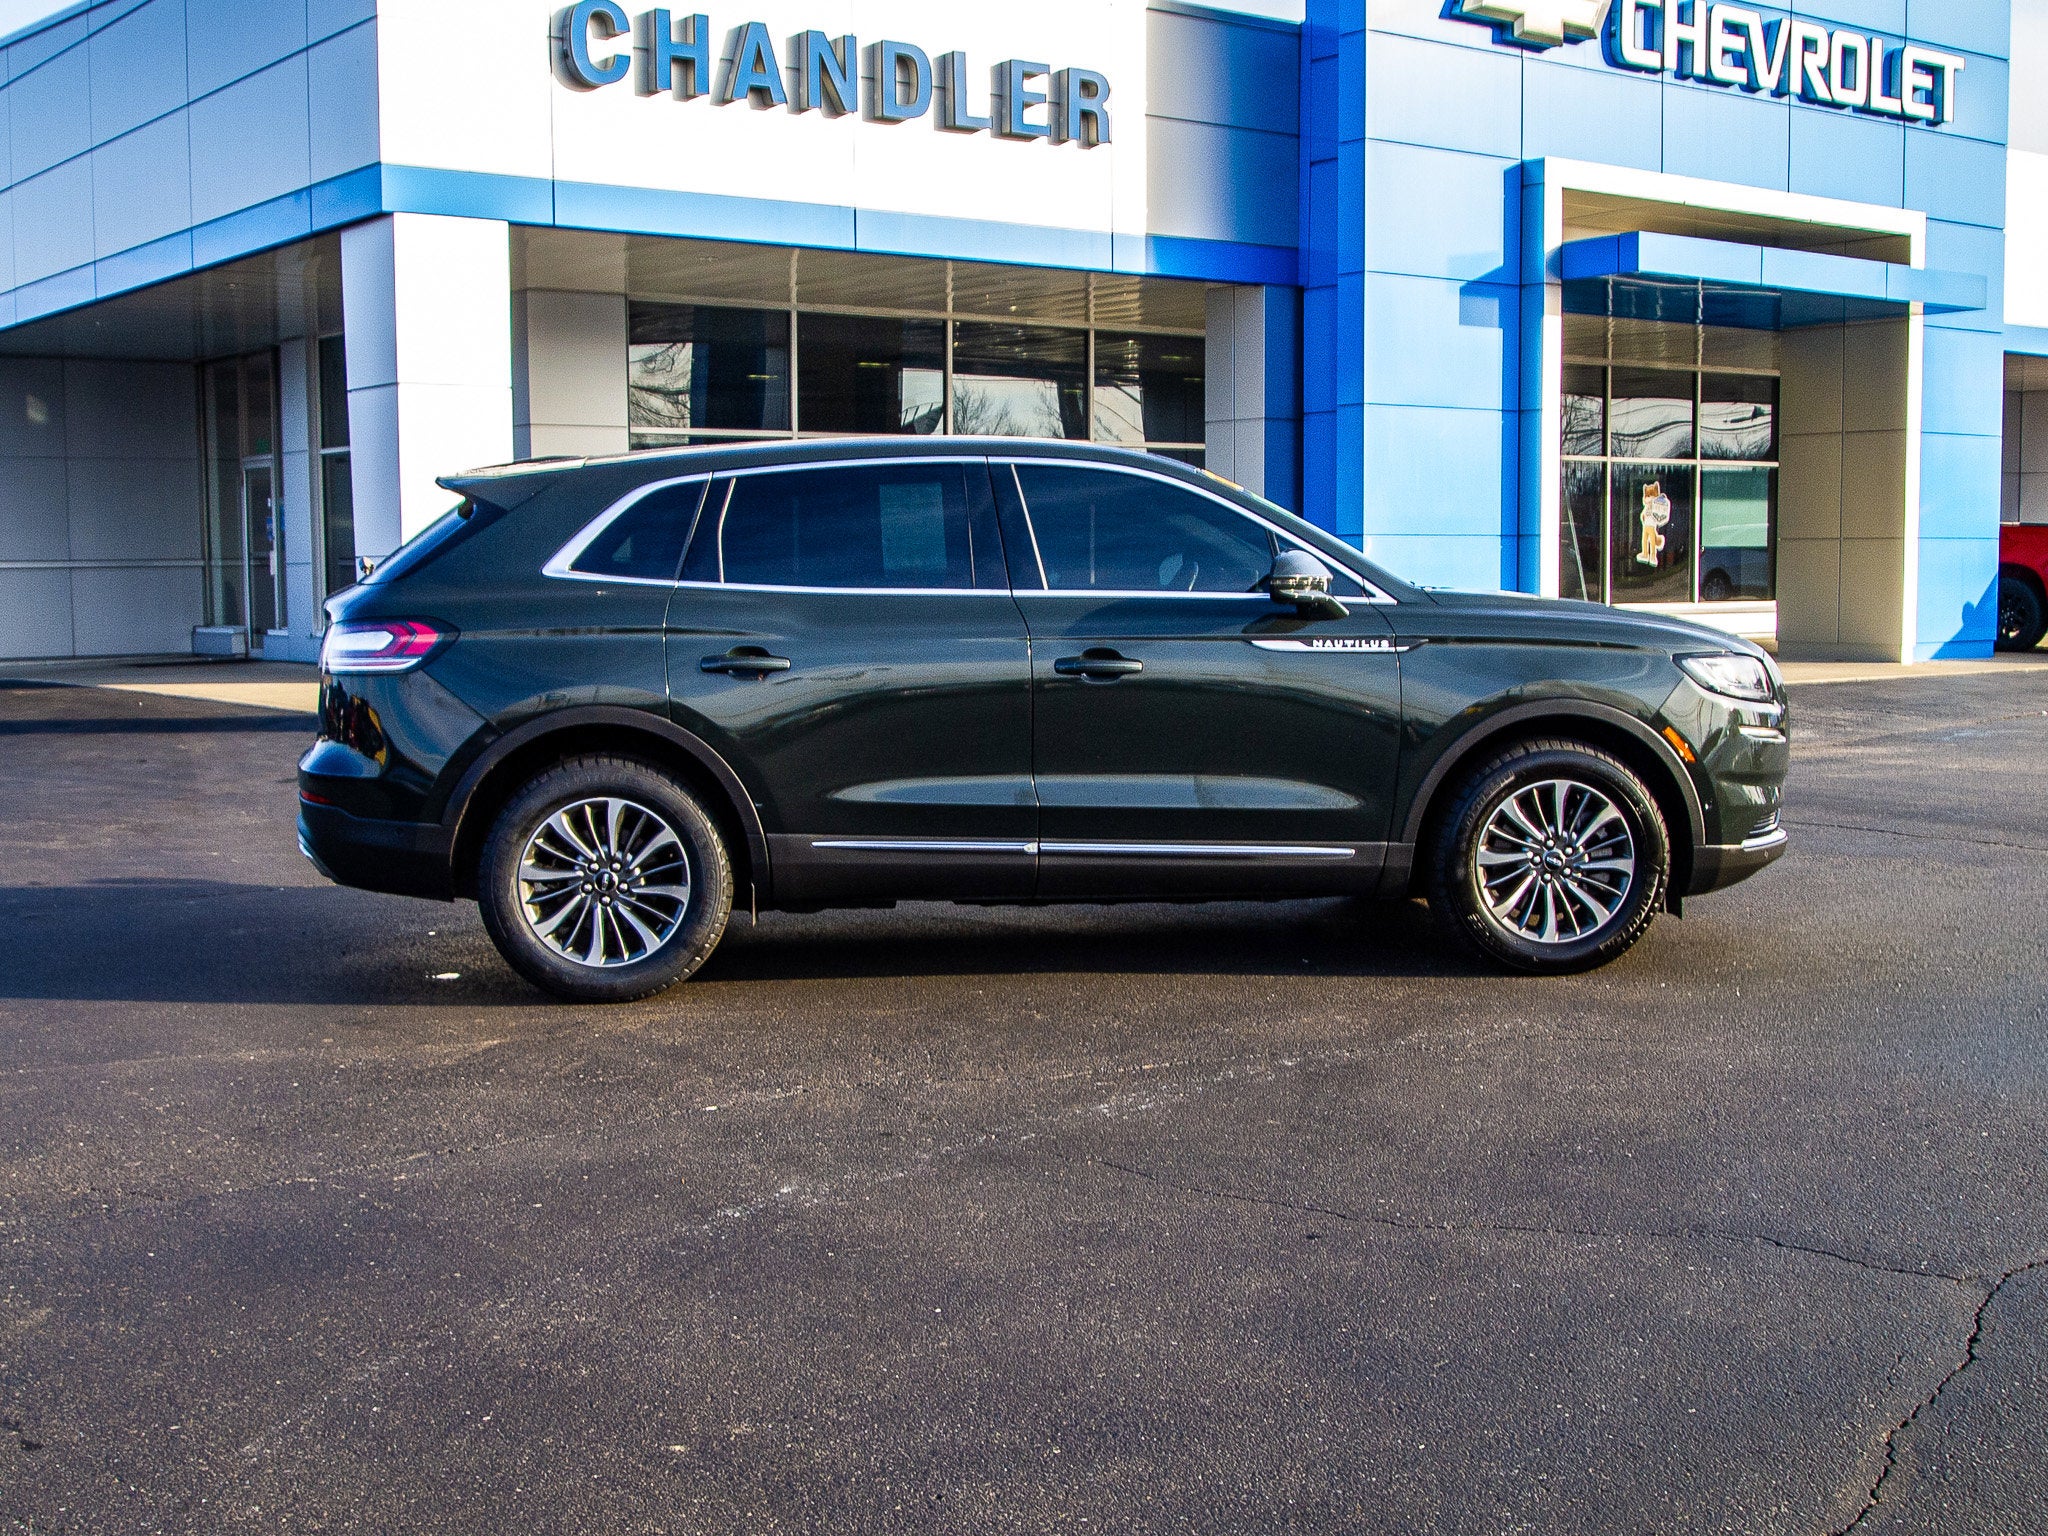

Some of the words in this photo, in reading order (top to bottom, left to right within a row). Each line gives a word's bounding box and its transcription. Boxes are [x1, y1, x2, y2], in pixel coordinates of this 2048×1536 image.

[552, 0, 1111, 147] CHANDLER
[1615, 0, 1966, 124] CHEVROLET
[1312, 639, 1390, 648] NAUTILUS
